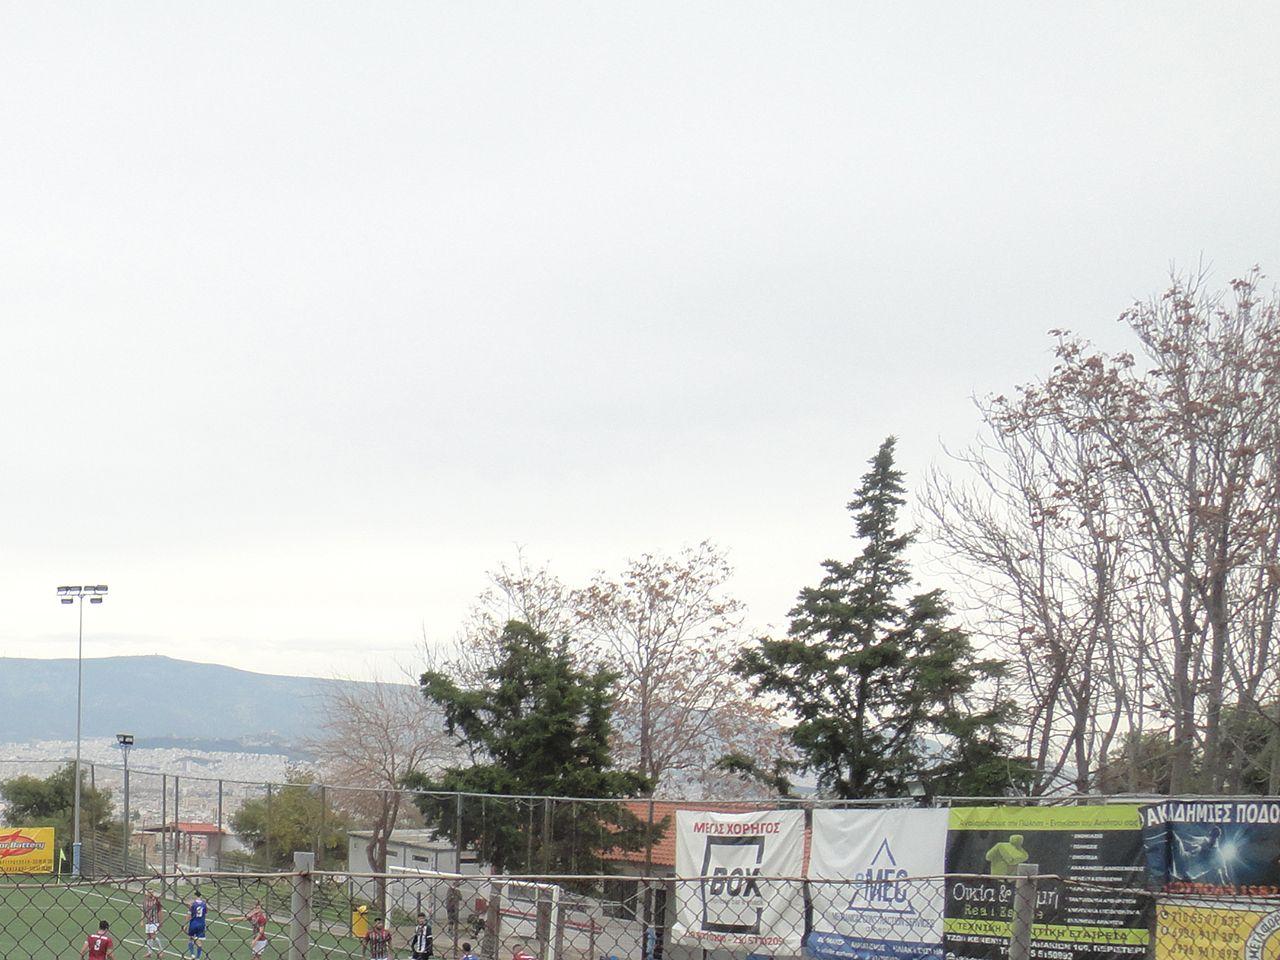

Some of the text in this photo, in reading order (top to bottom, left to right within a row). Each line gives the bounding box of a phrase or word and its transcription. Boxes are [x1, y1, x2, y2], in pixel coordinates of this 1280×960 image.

[1147, 803, 1232, 826] ΑΚΑΔΗΜΙΕΣ
[693, 822, 780, 834] ΜΕΓΑΣ ΧΟΡΗΓΟΣ
[10, 841, 46, 849] Battery
[710, 867, 762, 897] BOX
[964, 904, 995, 916] Real
[957, 922, 1001, 933] ΤΕΧΝΙΚΗ
[1070, 930, 1128, 941] ΕΤΑΙΡΕΙΑ
